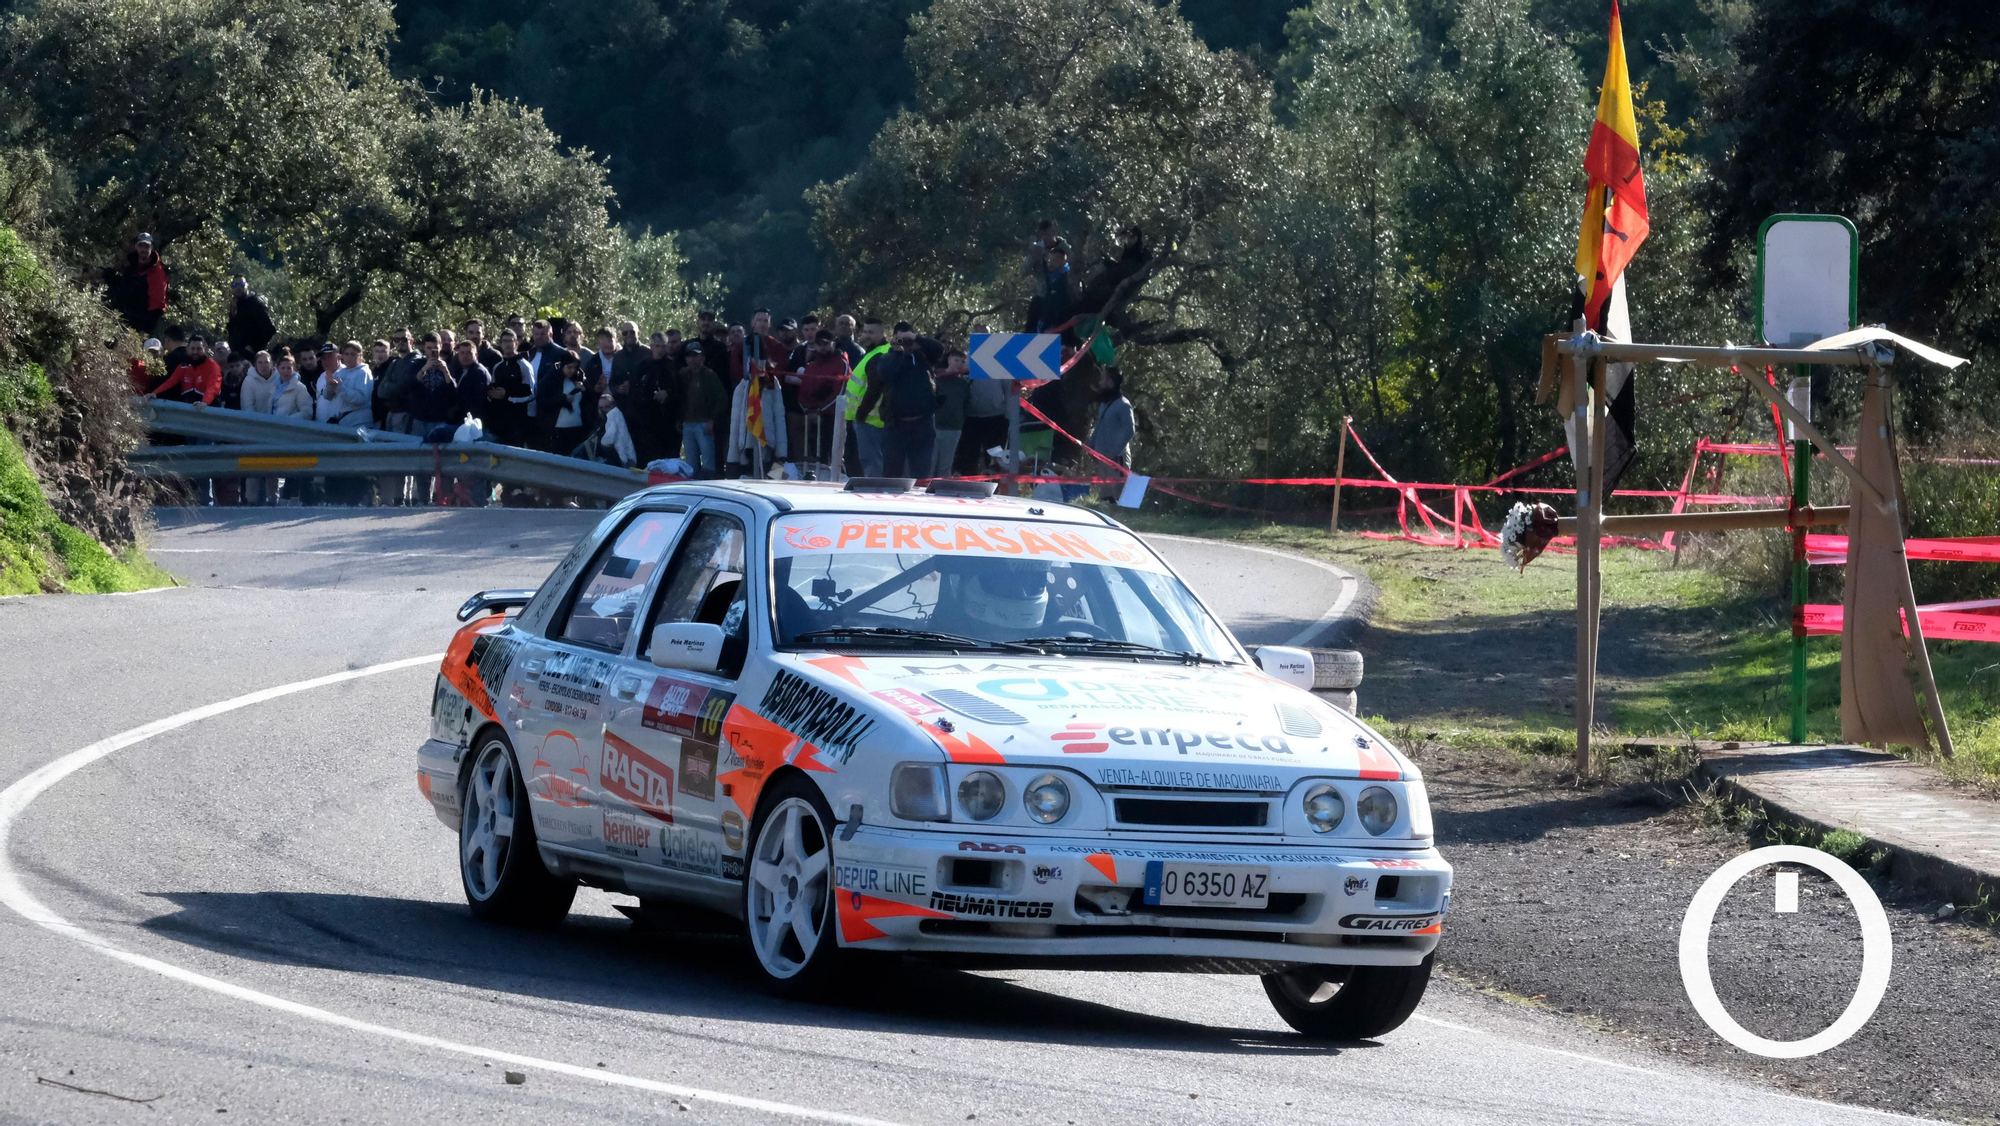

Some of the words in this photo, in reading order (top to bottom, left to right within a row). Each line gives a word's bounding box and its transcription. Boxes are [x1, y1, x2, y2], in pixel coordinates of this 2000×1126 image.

[836, 520, 1111, 562] PERCASAN
[683, 639, 705, 647] Martinez
[663, 685, 691, 705] AUTO
[1087, 692, 1209, 709] LINE
[702, 697, 727, 736] 10
[601, 742, 673, 816] RASTA
[1098, 768, 1193, 788] VENTA-ALQUILER
[1196, 773, 1211, 788] DE
[1214, 774, 1283, 790] MAQUINARIA
[603, 811, 650, 848] bernier
[672, 829, 718, 866] dielco
[1050, 846, 1124, 856] ALQUILER
[1125, 849, 1144, 858] DE
[1148, 851, 1250, 862] HERRAMIENTA
[1251, 854, 1262, 863] Y
[1262, 854, 1348, 864] MAQUINARIA
[835, 866, 879, 891] DEPUR
[884, 870, 927, 896] LINE
[1149, 887, 1157, 897] E
[1183, 871, 1236, 897] 6350
[1241, 873, 1267, 899] AZ
[1338, 911, 1439, 930] GALFRES
